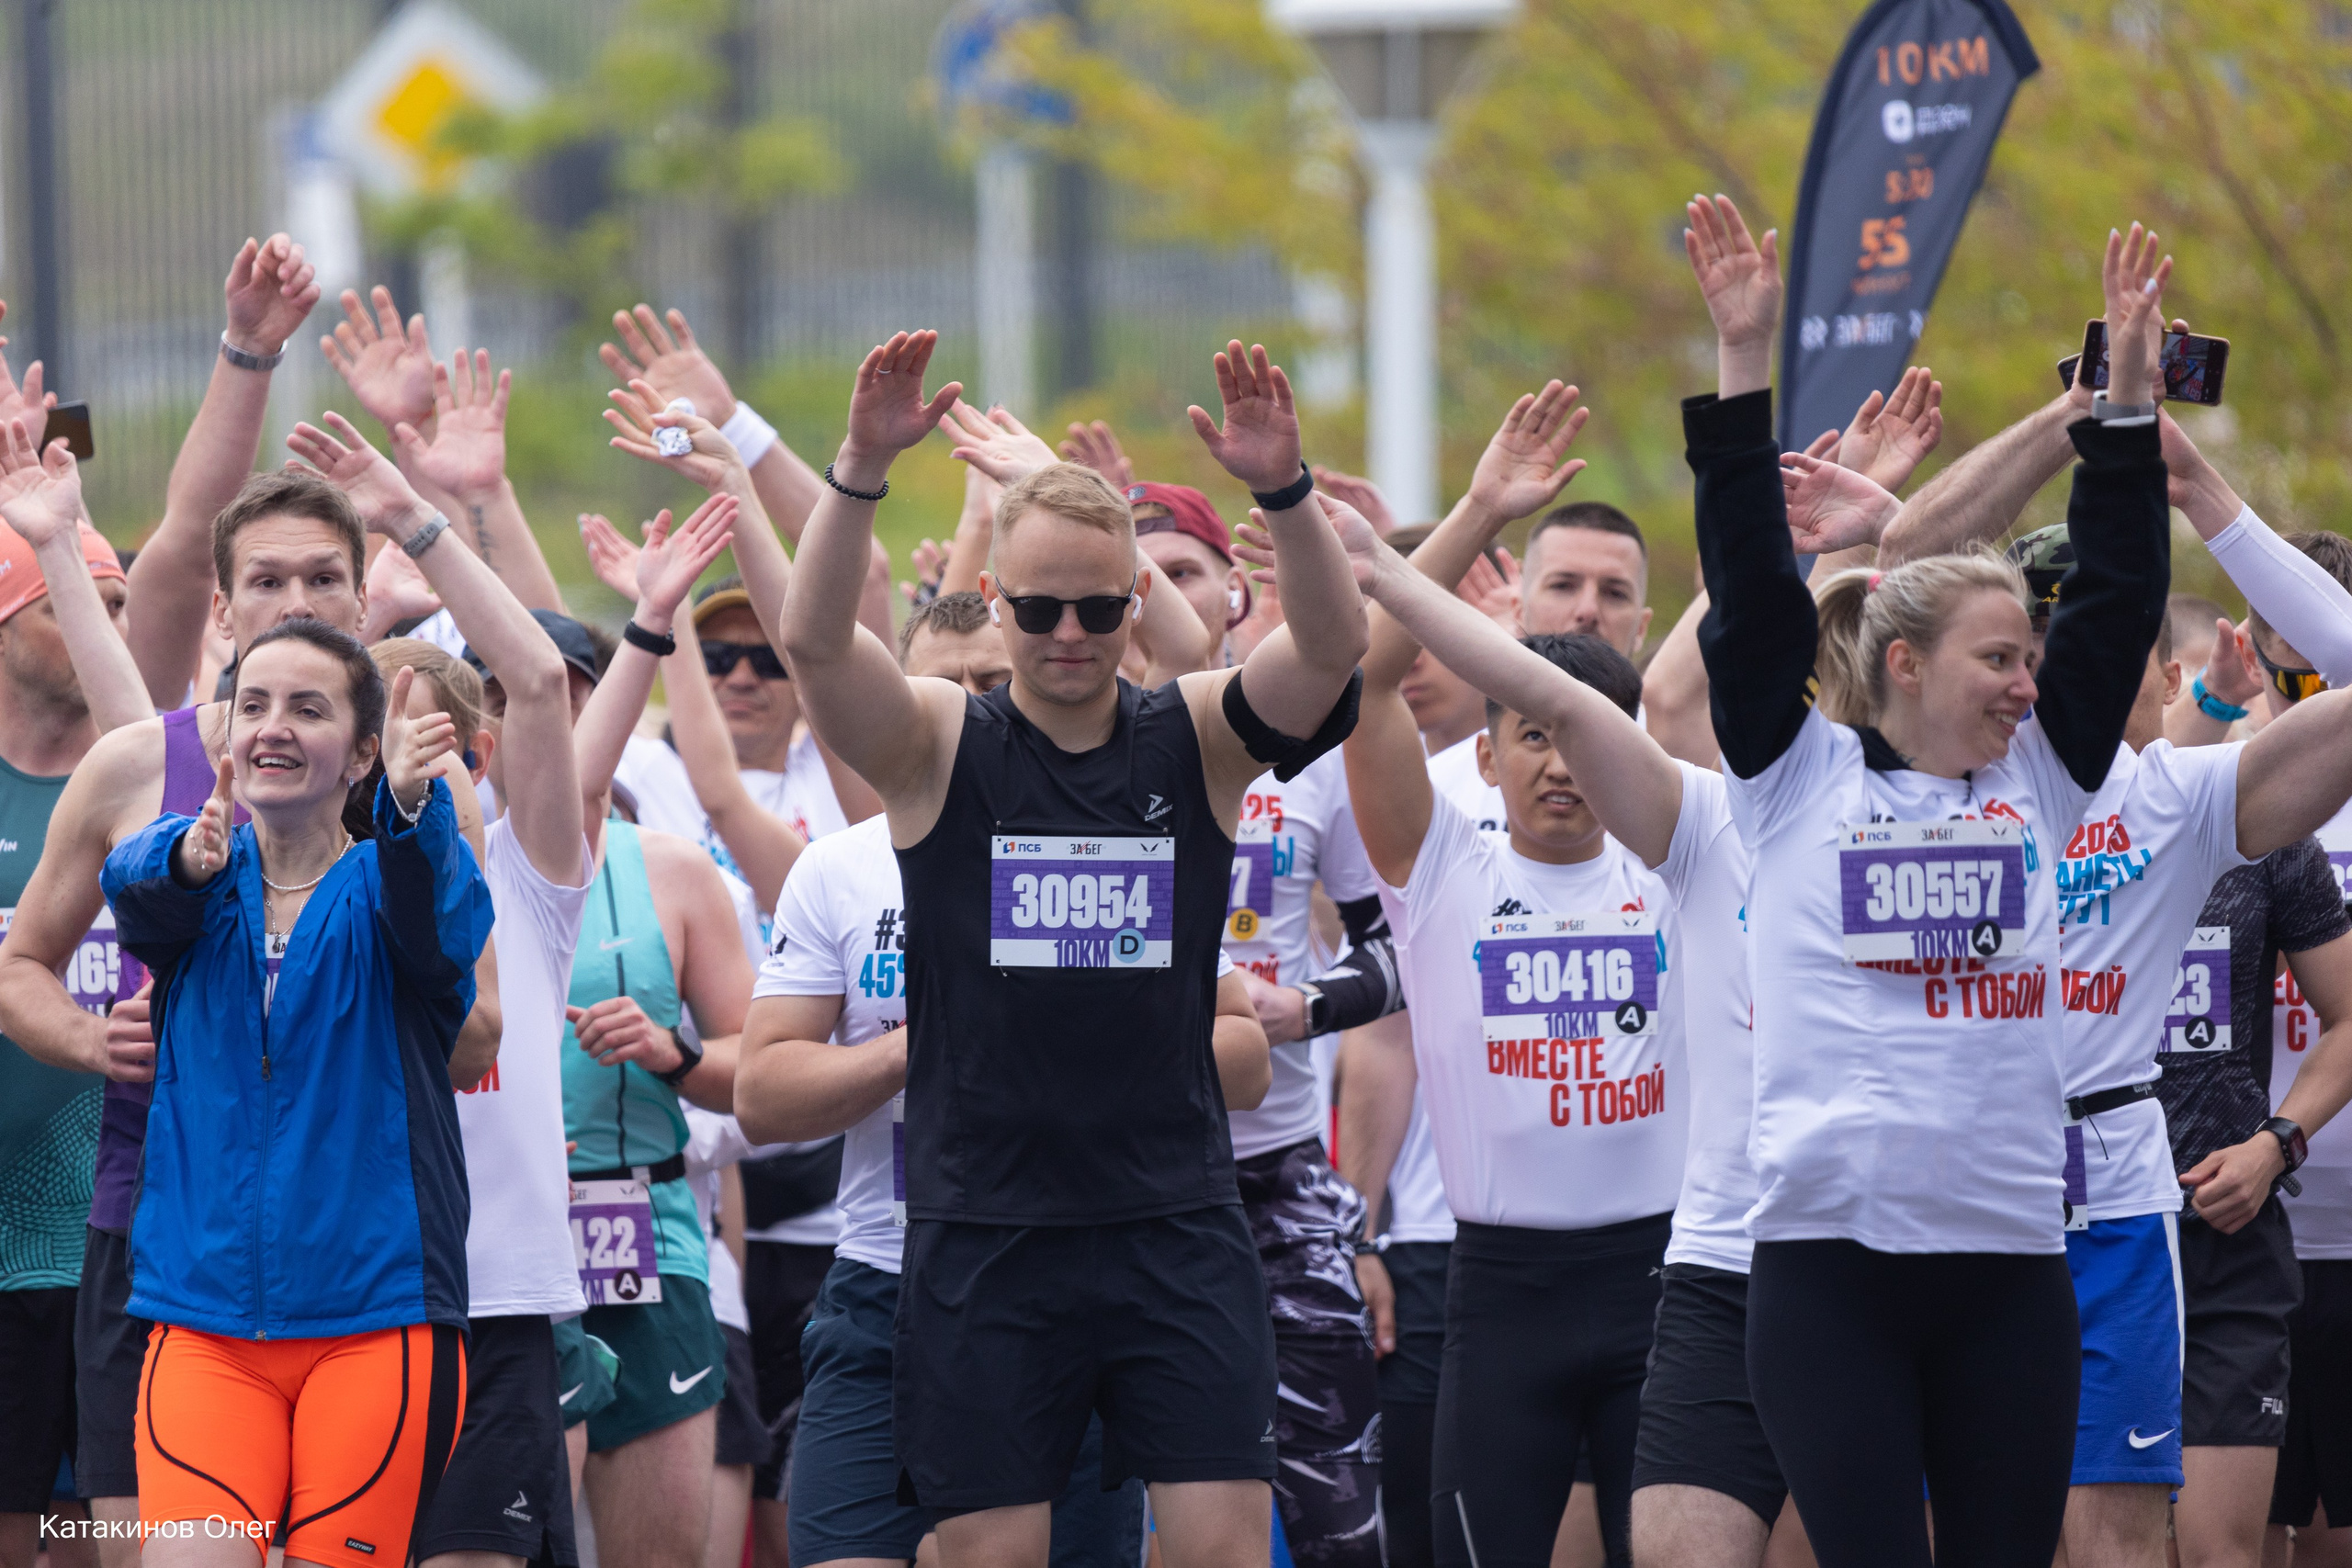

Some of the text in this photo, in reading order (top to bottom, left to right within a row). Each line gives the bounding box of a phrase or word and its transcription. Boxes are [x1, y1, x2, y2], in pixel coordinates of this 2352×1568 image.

[1018, 843, 1042, 852] ПСБ
[1867, 830, 1892, 841] ПСБ
[1012, 873, 1152, 929] 30954
[1866, 860, 2003, 921] 30557
[1120, 935, 1139, 955] D
[1505, 922, 1528, 932] ПСБ
[1505, 948, 1634, 1004] 30416
[1925, 964, 2046, 1019] С ТОБОЙ
[1487, 1037, 1606, 1081] ВМЕСТЕ
[1550, 1062, 1665, 1127] С ТОБОЙ
[570, 1215, 639, 1271] 422
[503, 1507, 533, 1523] DEMIX
